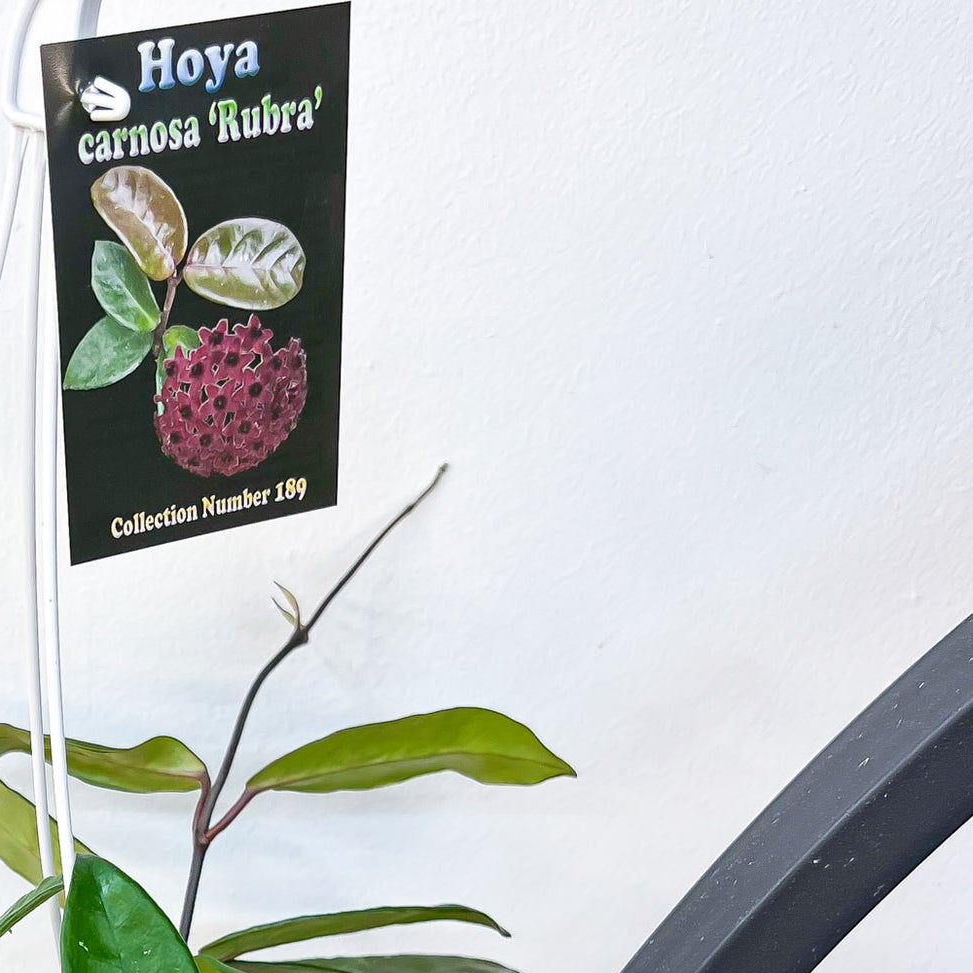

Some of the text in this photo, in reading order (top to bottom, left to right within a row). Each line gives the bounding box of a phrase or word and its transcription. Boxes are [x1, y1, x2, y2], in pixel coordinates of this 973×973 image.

[137, 38, 260, 93] Hoya
[78, 116, 201, 165] carnosa
[110, 477, 308, 539] Collection Number 189
